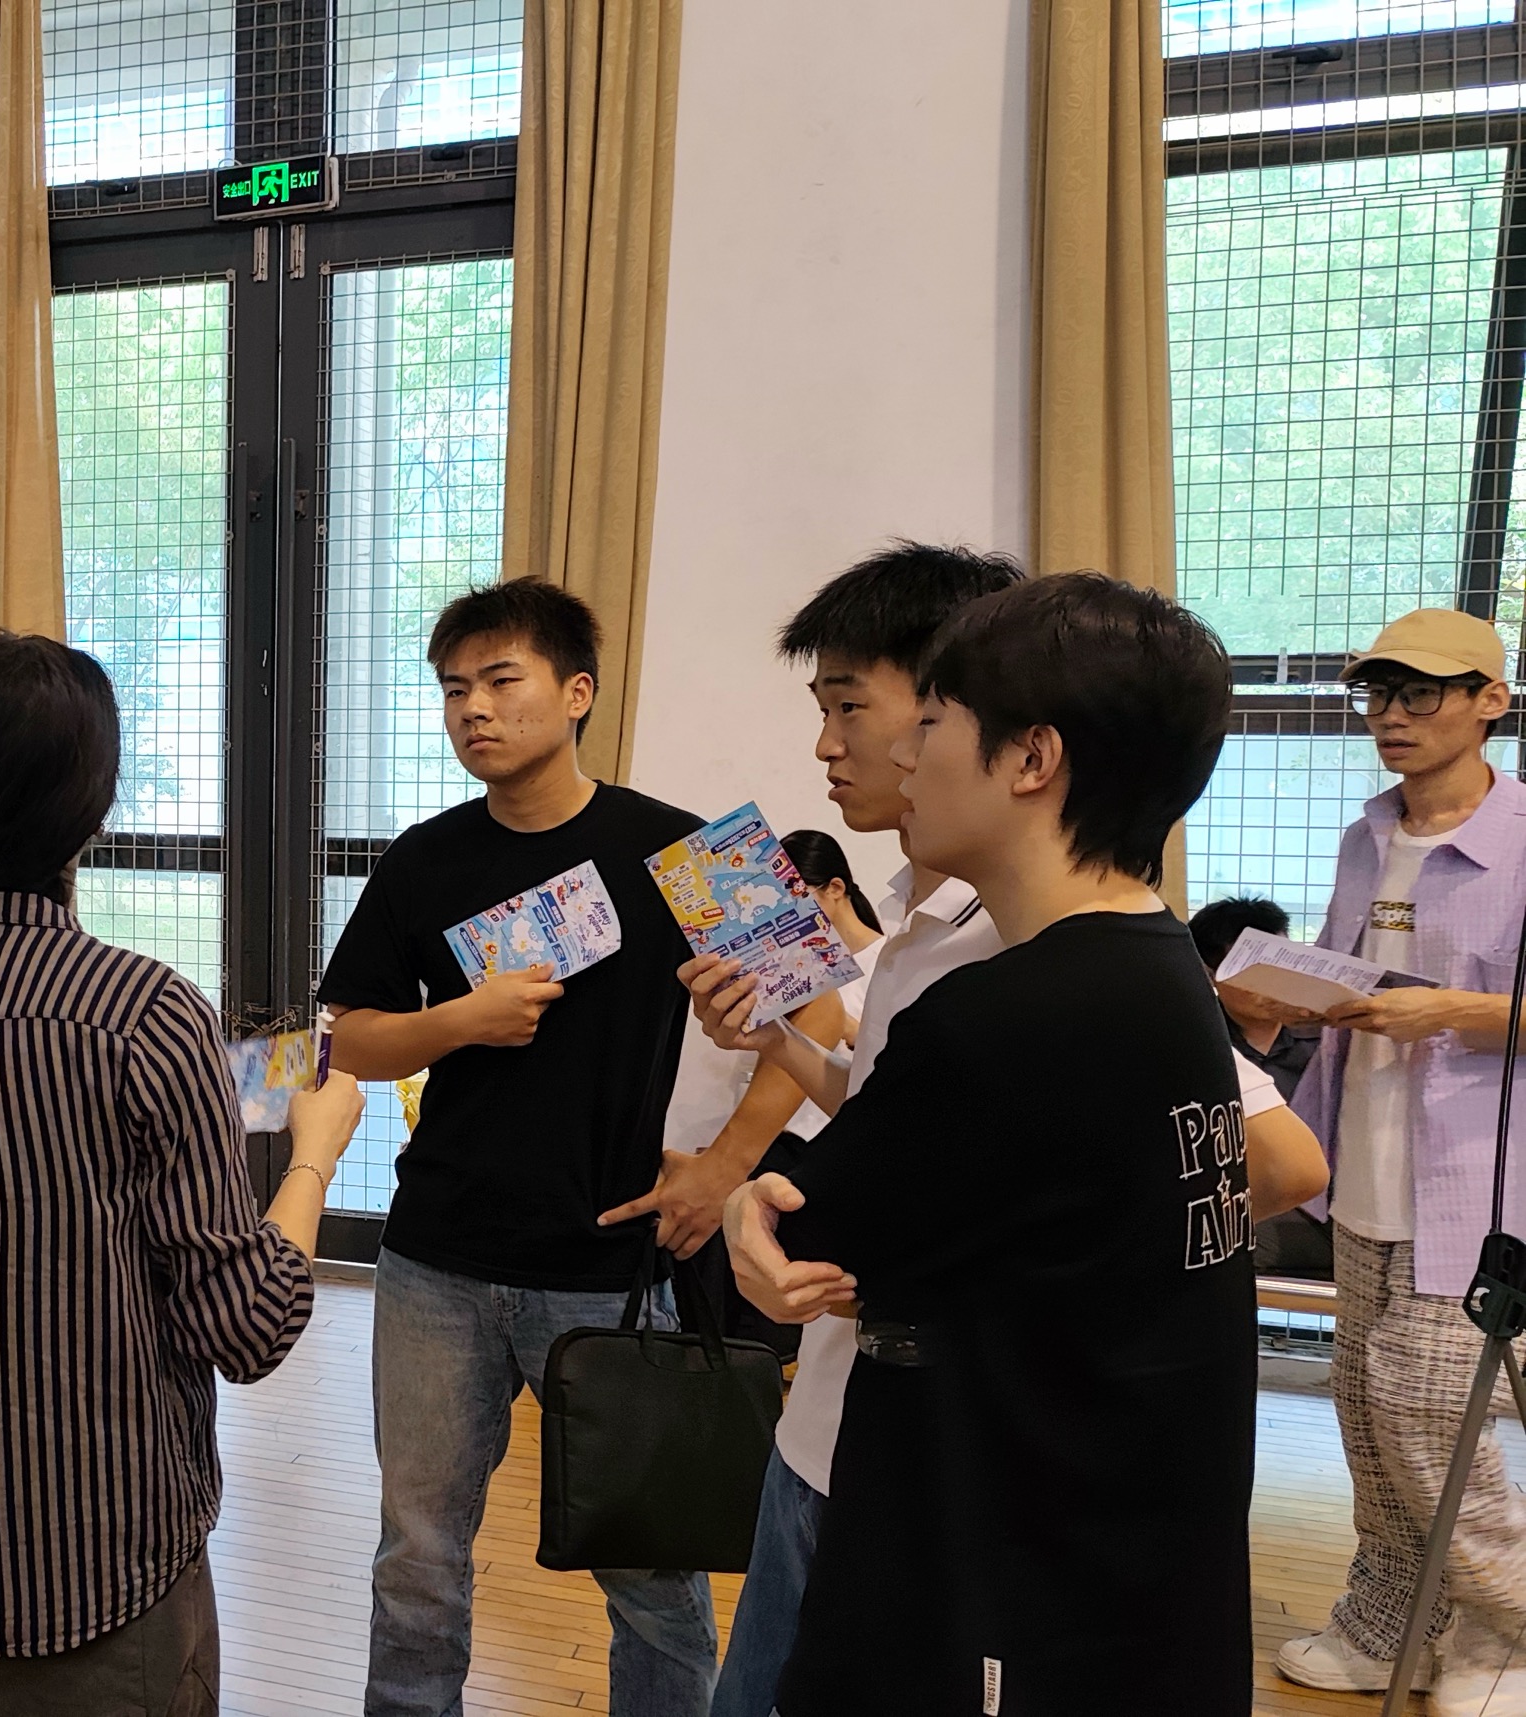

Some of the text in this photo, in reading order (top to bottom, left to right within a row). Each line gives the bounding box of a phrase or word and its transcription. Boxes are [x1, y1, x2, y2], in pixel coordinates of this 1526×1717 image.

[290, 170, 320, 189] EXIT
[222, 180, 252, 198] 安全出口
